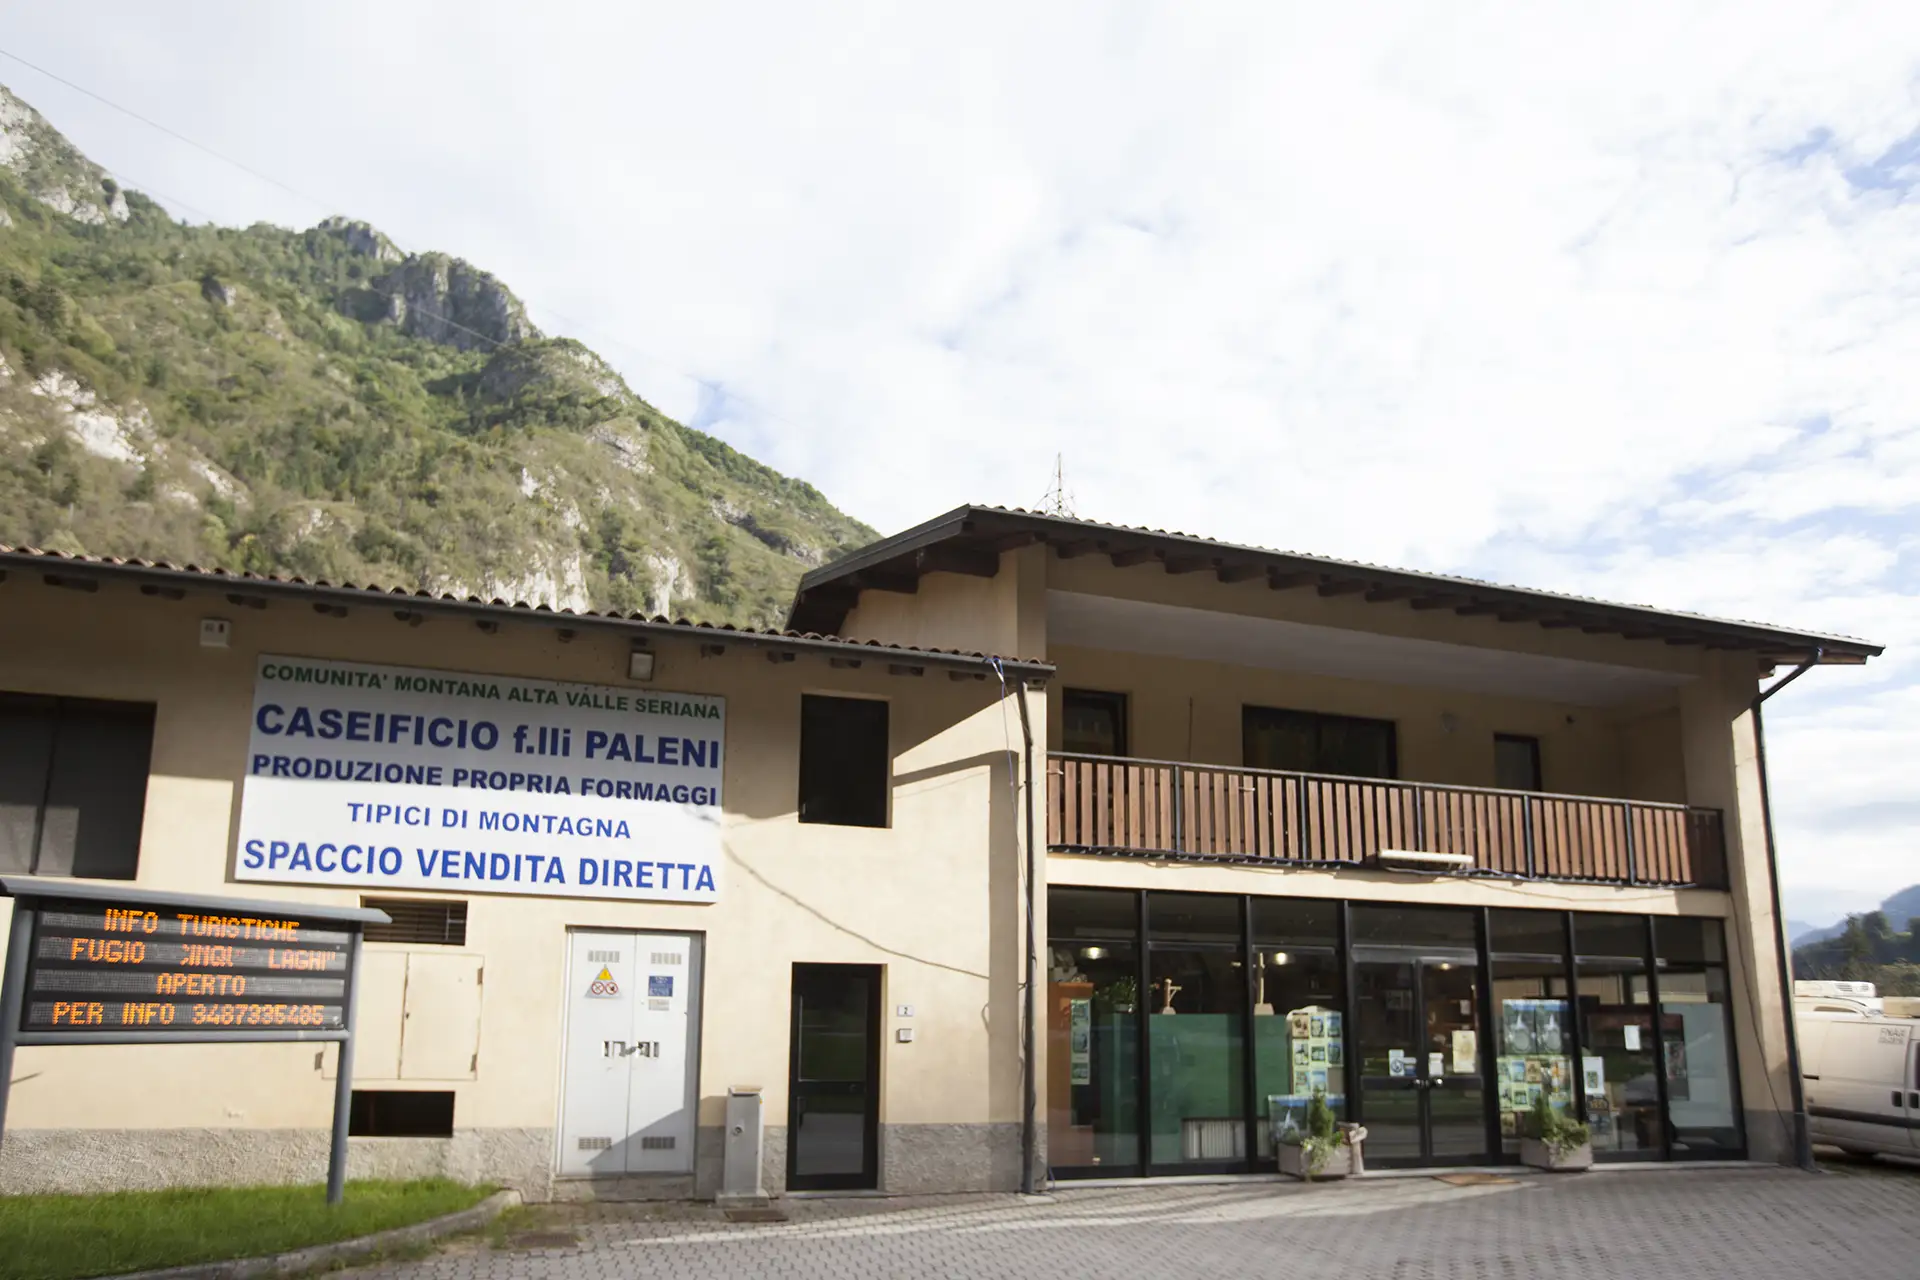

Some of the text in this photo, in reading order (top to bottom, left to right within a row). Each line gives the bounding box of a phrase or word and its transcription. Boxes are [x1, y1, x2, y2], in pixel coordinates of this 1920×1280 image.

[262, 664, 720, 719] COMUNITA' MONTANA ALTA VALLE SERIANA
[256, 704, 719, 768] CASEIFICIO f.lli PALENI
[252, 754, 716, 806] PRODUZIONE PROPRIA FORMAGGI
[347, 802, 631, 839] TIPICI DI MONTAGNA
[243, 839, 716, 892] SPACCIO VENDITA DIRETTA
[103, 908, 300, 942] INFO TURISTICHE
[155, 972, 247, 996] APERTO
[51, 1001, 104, 1025] PER
[121, 1002, 176, 1025] INFO
